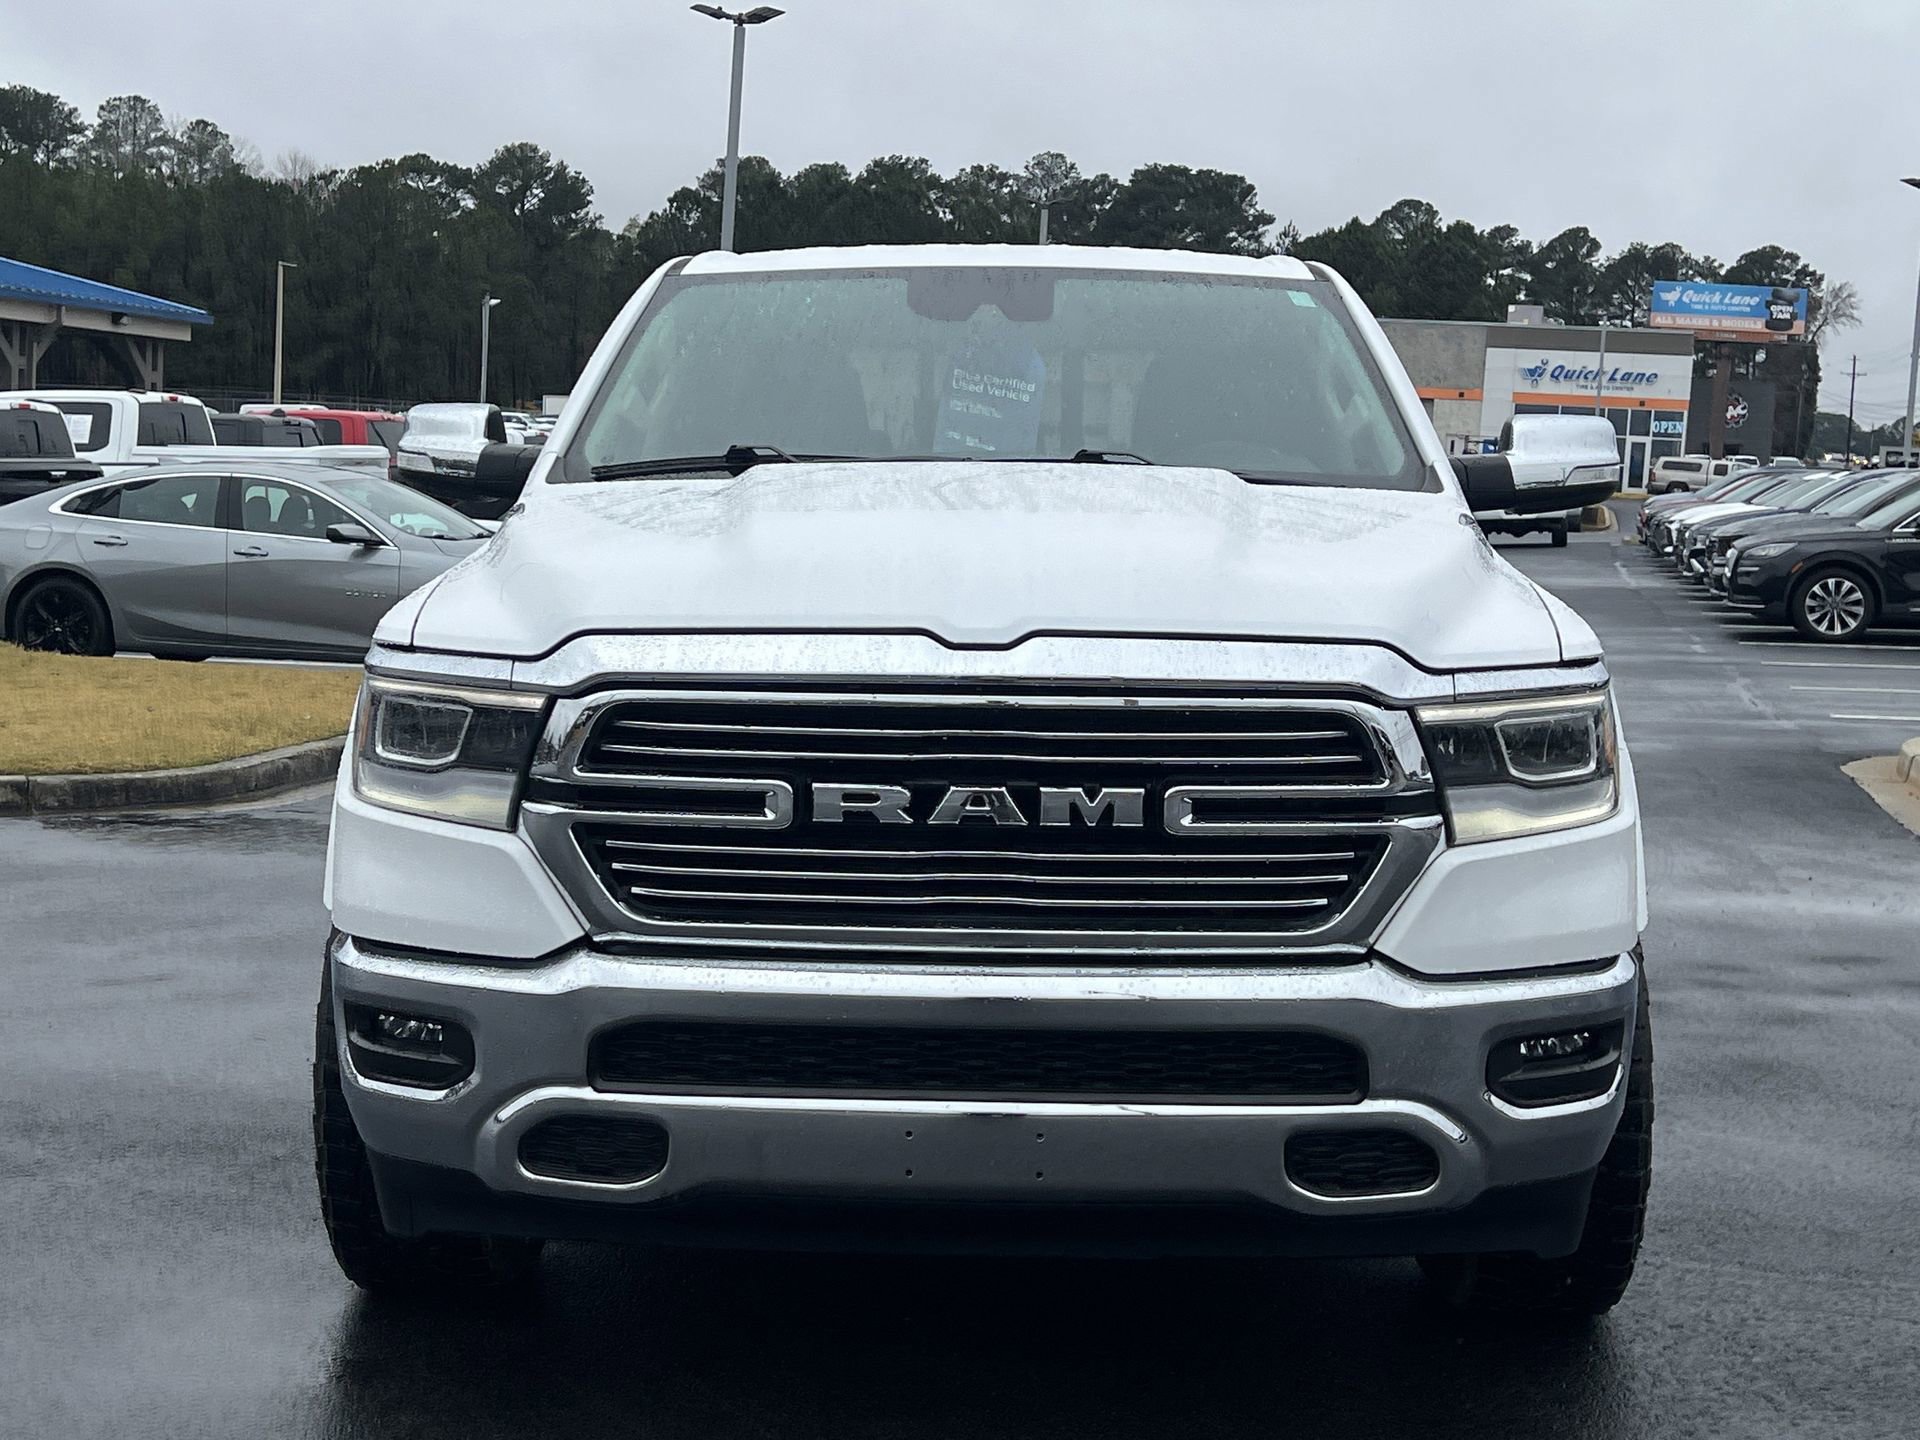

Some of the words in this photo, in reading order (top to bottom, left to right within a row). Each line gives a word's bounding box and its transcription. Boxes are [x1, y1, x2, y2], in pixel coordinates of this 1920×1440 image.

[1682, 289, 1723, 304] Quick
[1723, 291, 1760, 306] Lane
[1770, 304, 1793, 313] OPEN
[1655, 316, 1674, 324] ALL
[1721, 319, 1762, 329] MODELS
[1608, 368, 1658, 385] Lane
[952, 376, 984, 393] Used
[986, 383, 1030, 402] Vehicle
[1653, 421, 1684, 434] OPEN
[811, 782, 1146, 828] RAM
